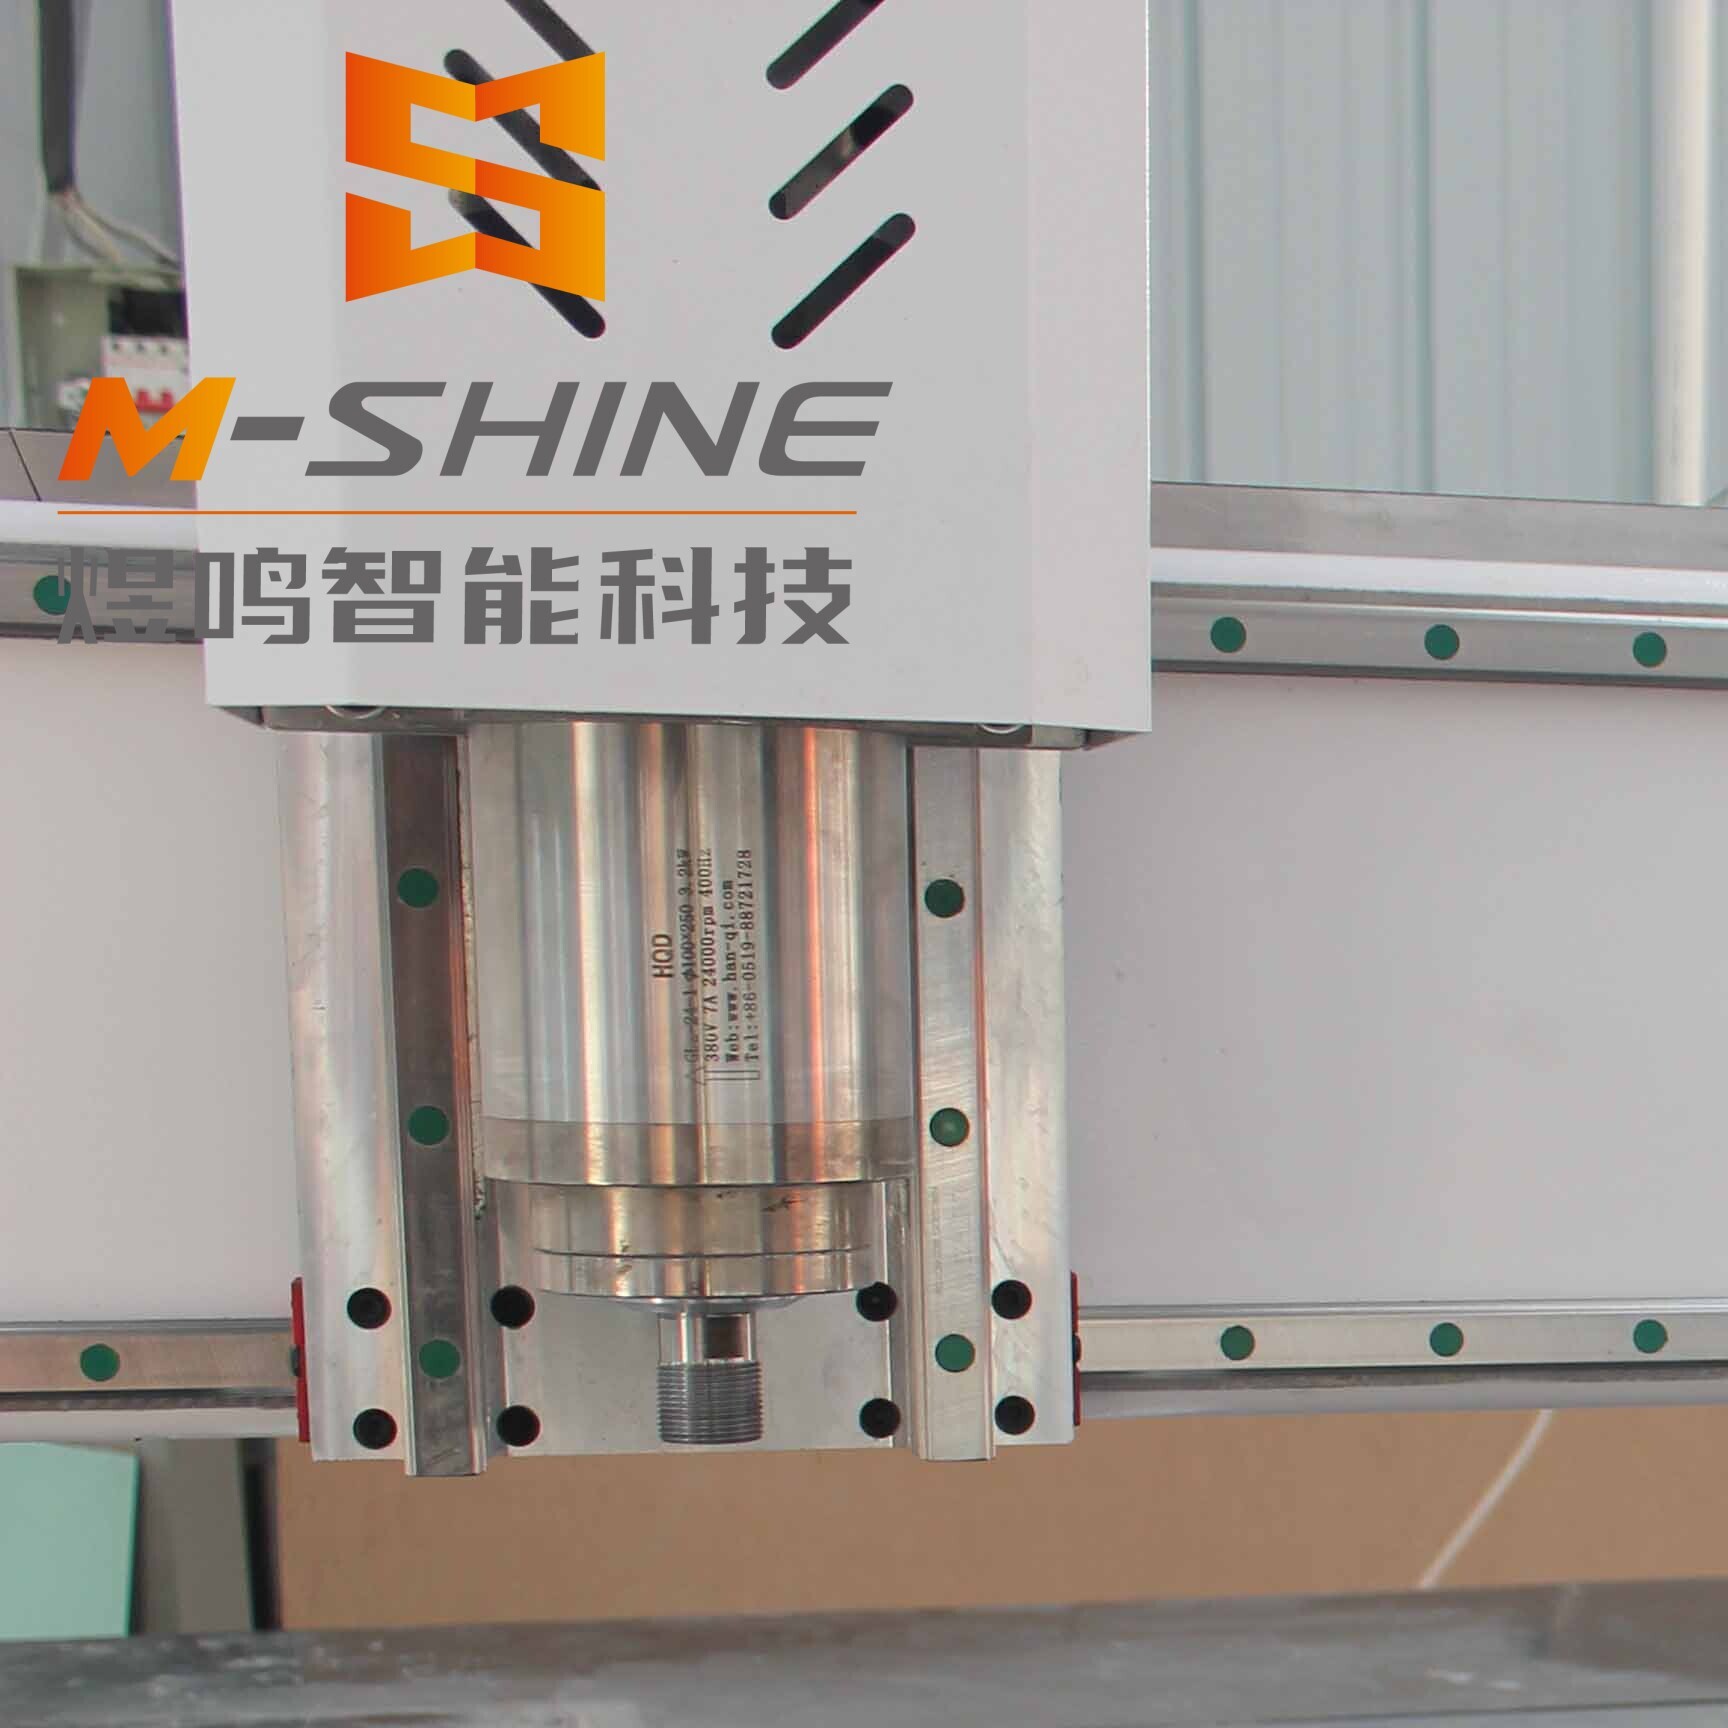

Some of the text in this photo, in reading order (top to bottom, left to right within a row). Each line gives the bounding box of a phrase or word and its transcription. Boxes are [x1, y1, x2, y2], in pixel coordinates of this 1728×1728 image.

[651, 933, 675, 979] HQD
[700, 906, 717, 987] 24000rpm
[703, 995, 719, 1014] 7A
[702, 1023, 720, 1062] 380V
